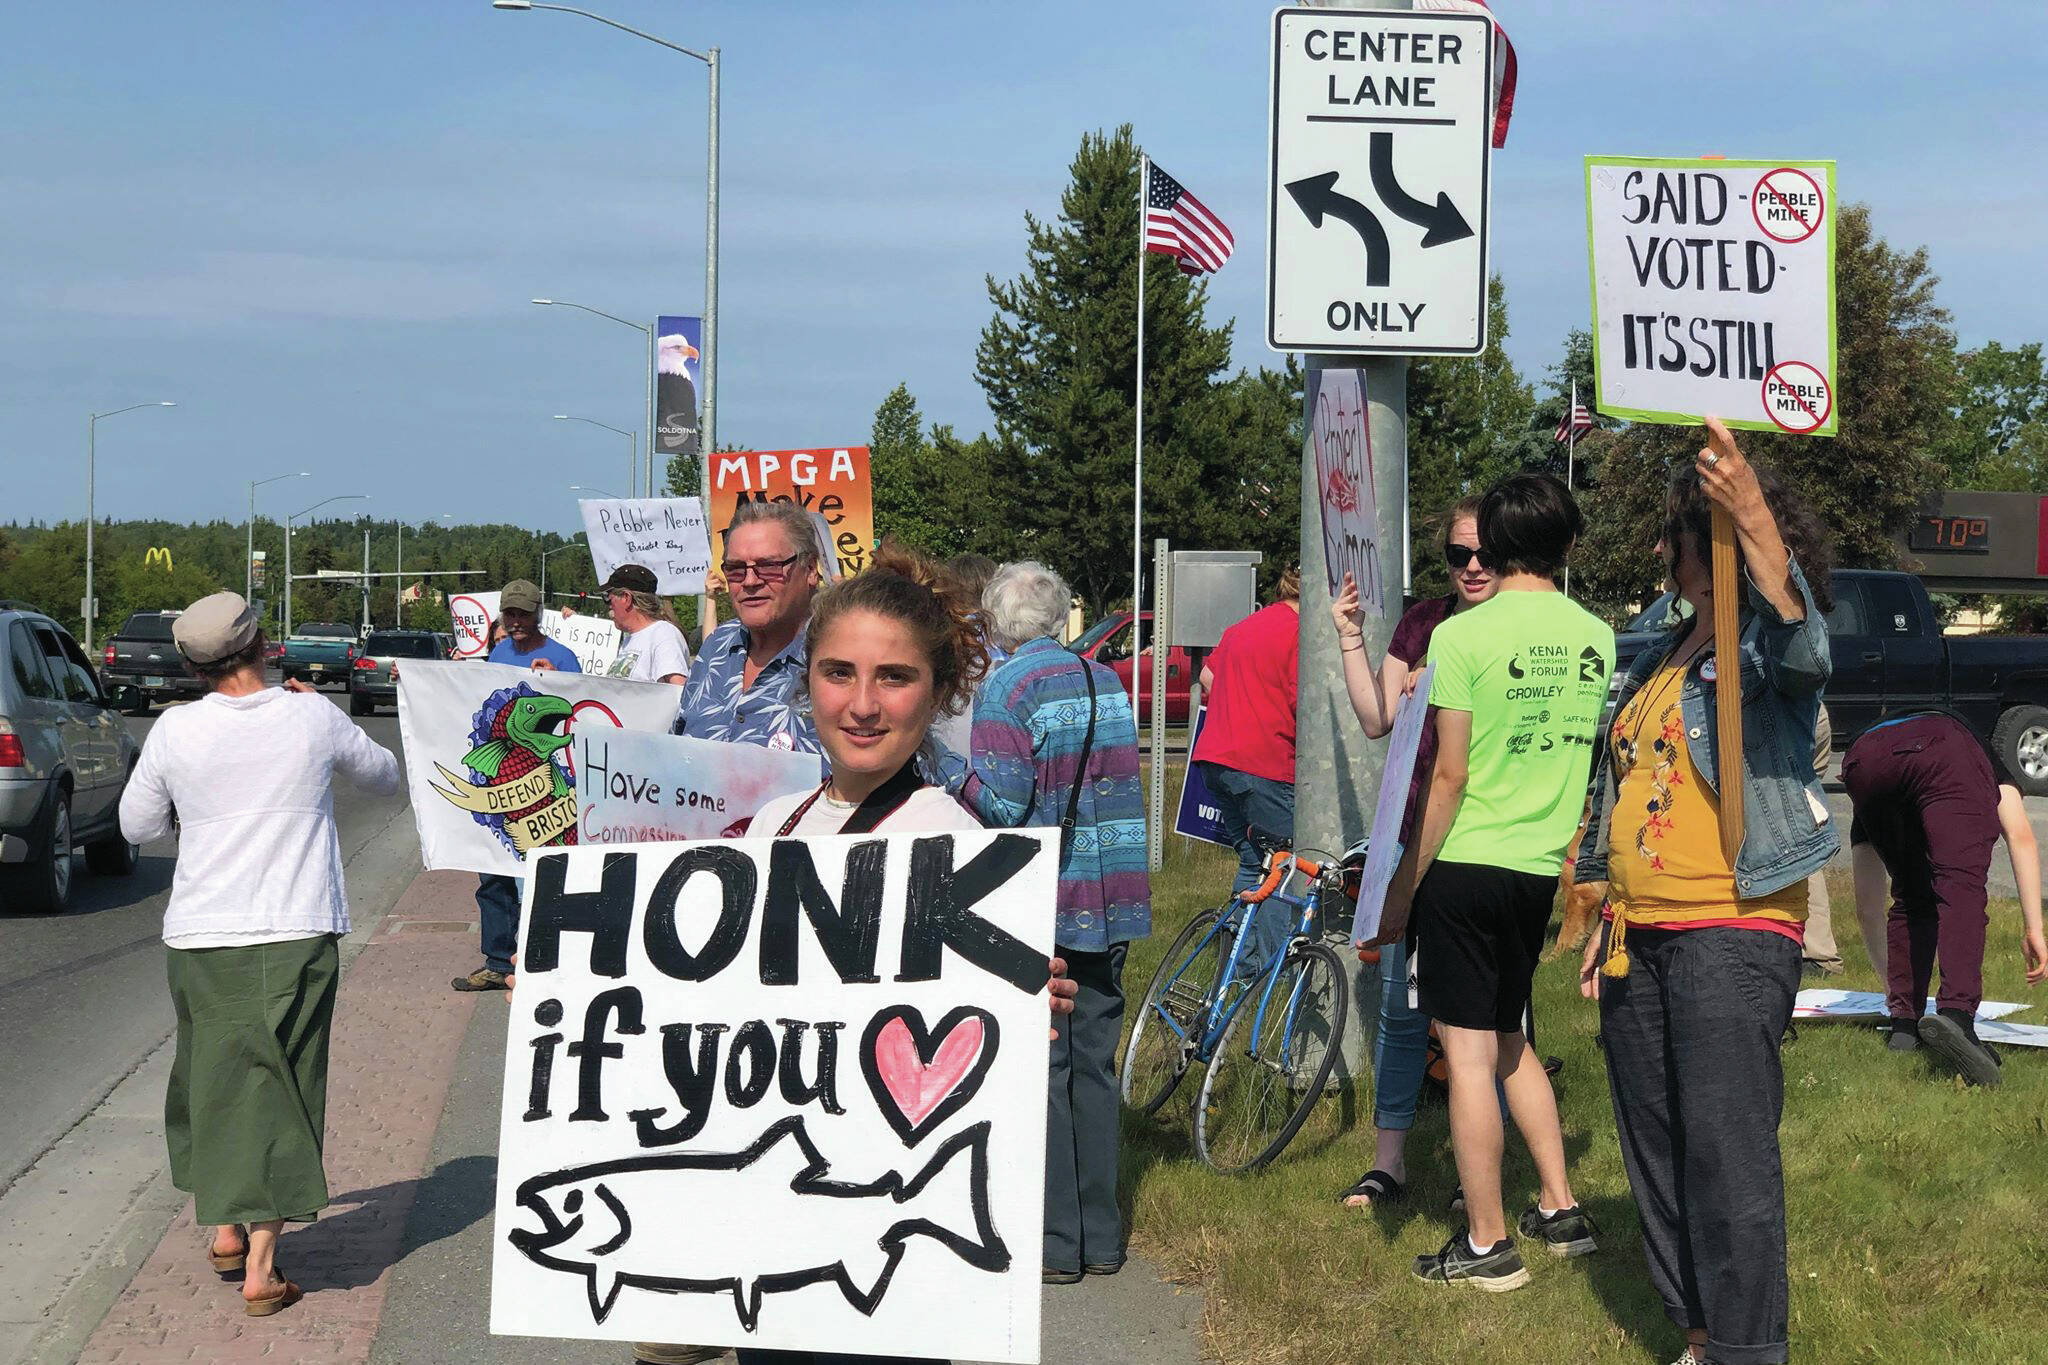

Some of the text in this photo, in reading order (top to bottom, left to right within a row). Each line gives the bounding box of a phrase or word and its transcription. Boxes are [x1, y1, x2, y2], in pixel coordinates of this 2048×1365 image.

[1304, 29, 1462, 65] CENTER
[1328, 74, 1436, 107] LANE
[1758, 192, 1817, 207] PEBBLE
[1767, 208, 1809, 222] MINE
[1326, 300, 1427, 332] ONLY
[1767, 383, 1825, 399] PEBBLE
[1776, 398, 1817, 413] MINE
[657, 426, 697, 435] SOLDOTNA
[716, 450, 856, 490] MPGA
[599, 505, 702, 533] Pebble Never
[664, 540, 684, 553] Bay
[569, 626, 579, 642] is
[585, 624, 613, 647] not
[1529, 645, 1568, 656] KENAI
[1531, 666, 1568, 676] FORUM
[1506, 685, 1564, 700] CROWLEY
[585, 737, 726, 813] Have some
[487, 774, 546, 810] DEFEND
[526, 797, 578, 842] BRISTO
[1198, 804, 1224, 824] VOT
[524, 833, 1053, 996] HONK
[523, 986, 847, 1148] if you
